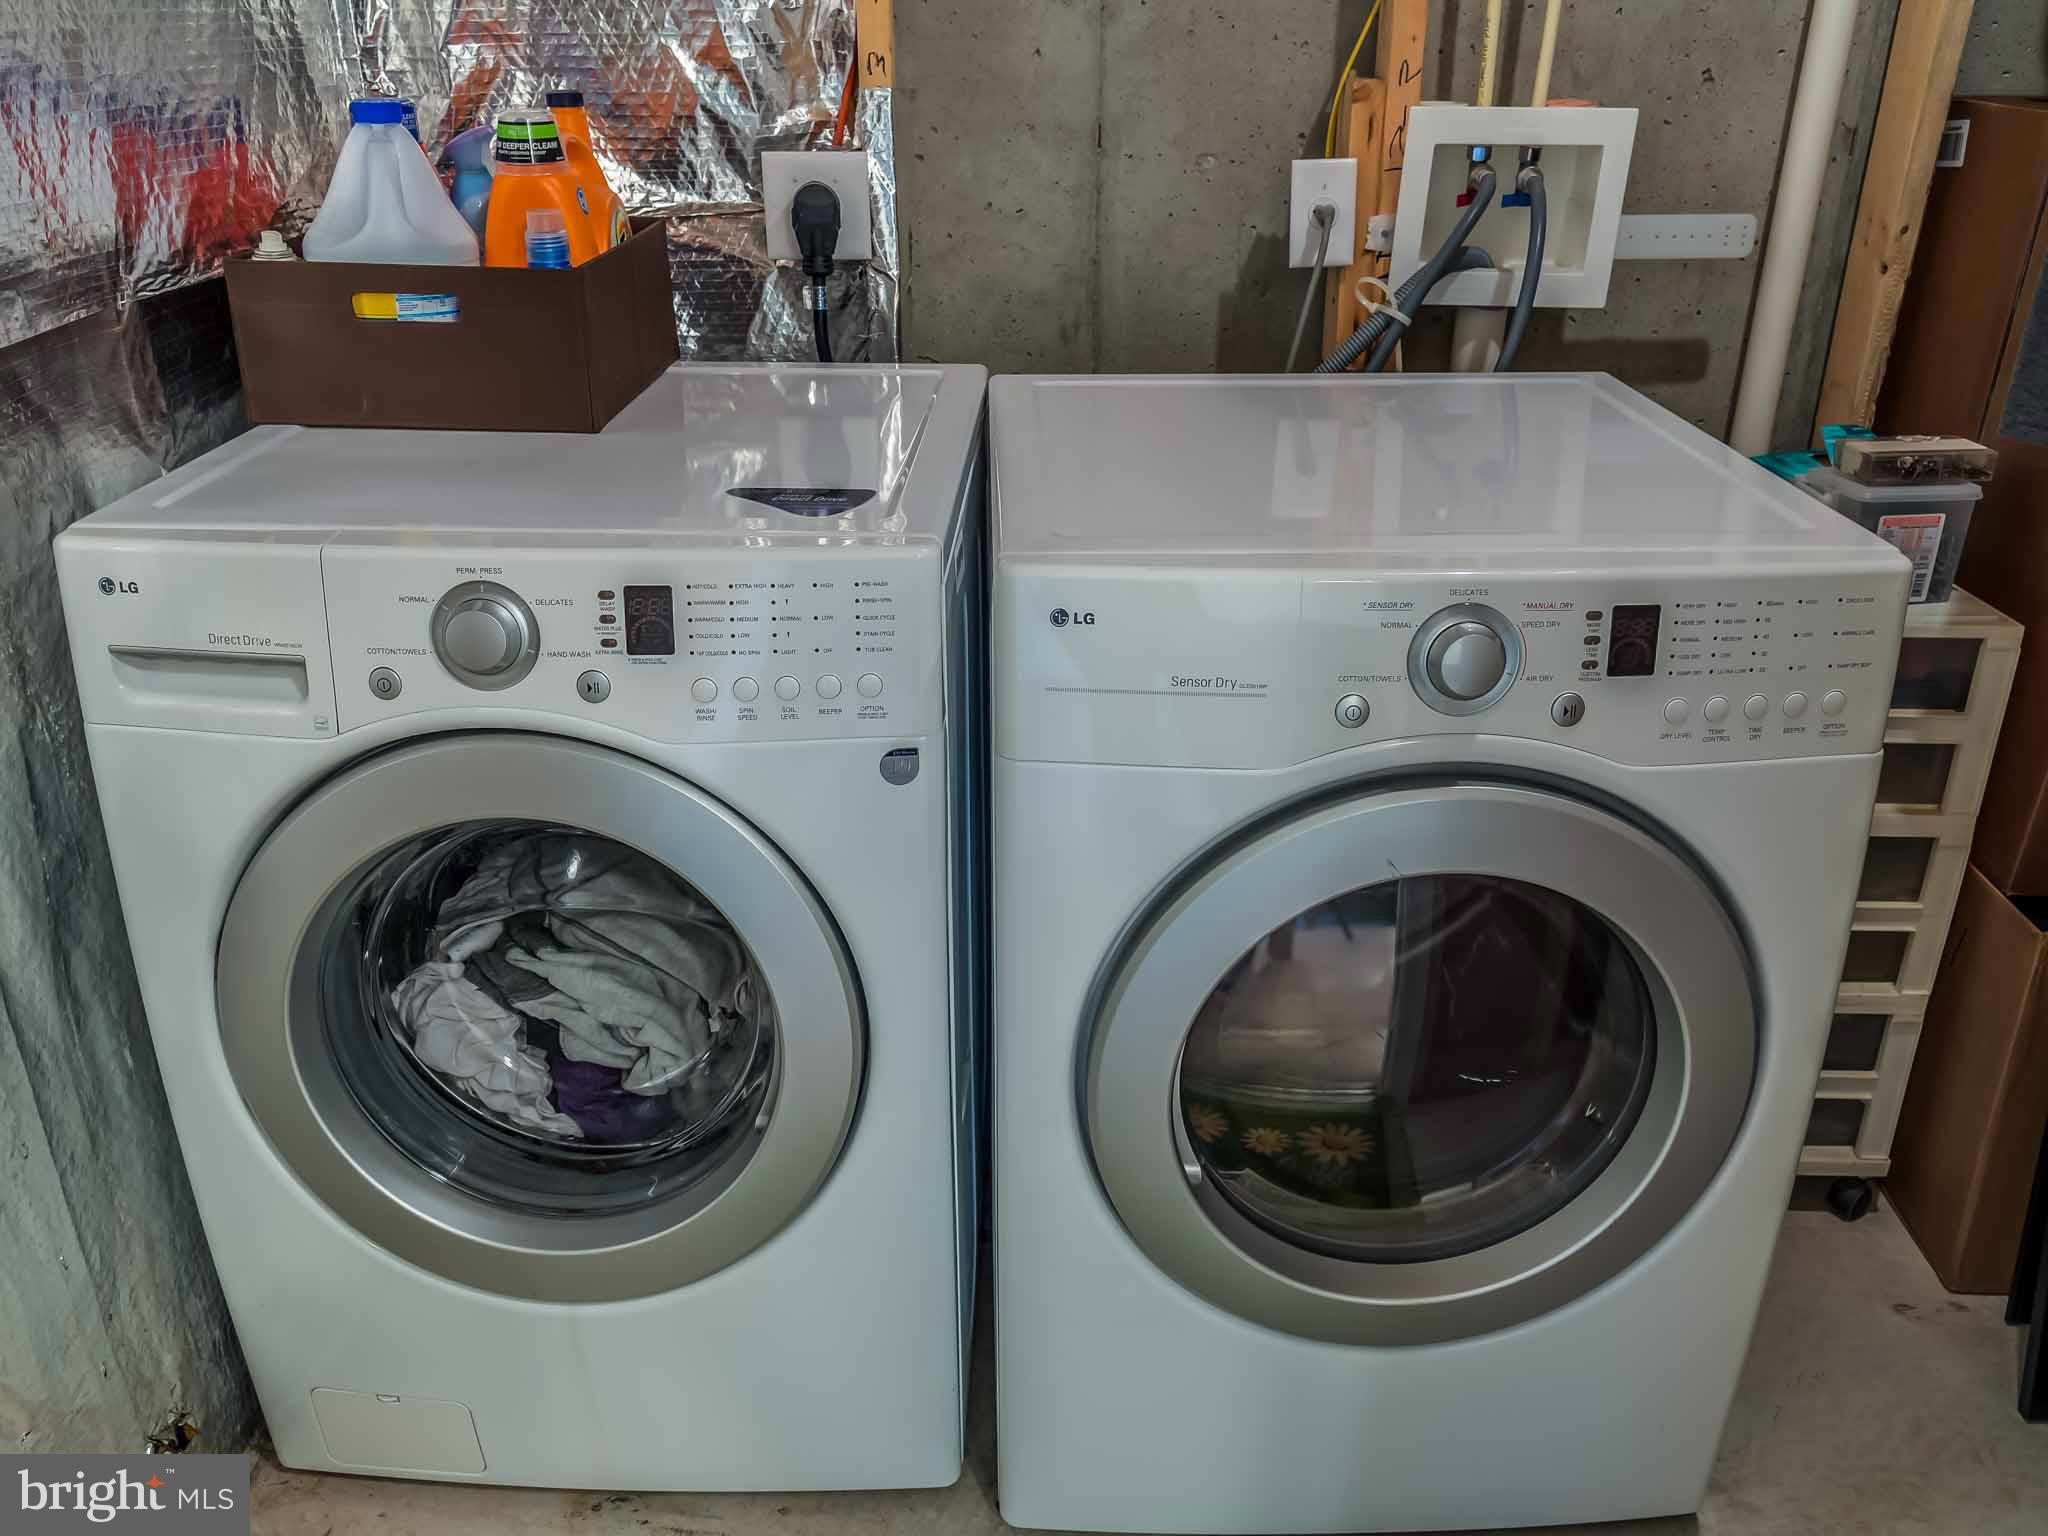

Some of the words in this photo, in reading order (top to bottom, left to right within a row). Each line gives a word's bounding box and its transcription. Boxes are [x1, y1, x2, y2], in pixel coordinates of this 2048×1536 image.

[502, 142, 530, 150] DEEPER
[1367, 602, 1397, 610] SENSOR
[1398, 602, 1416, 610] DRY
[242, 635, 272, 648] Drive
[1170, 675, 1214, 689] Sensor
[1215, 676, 1239, 692] Dry
